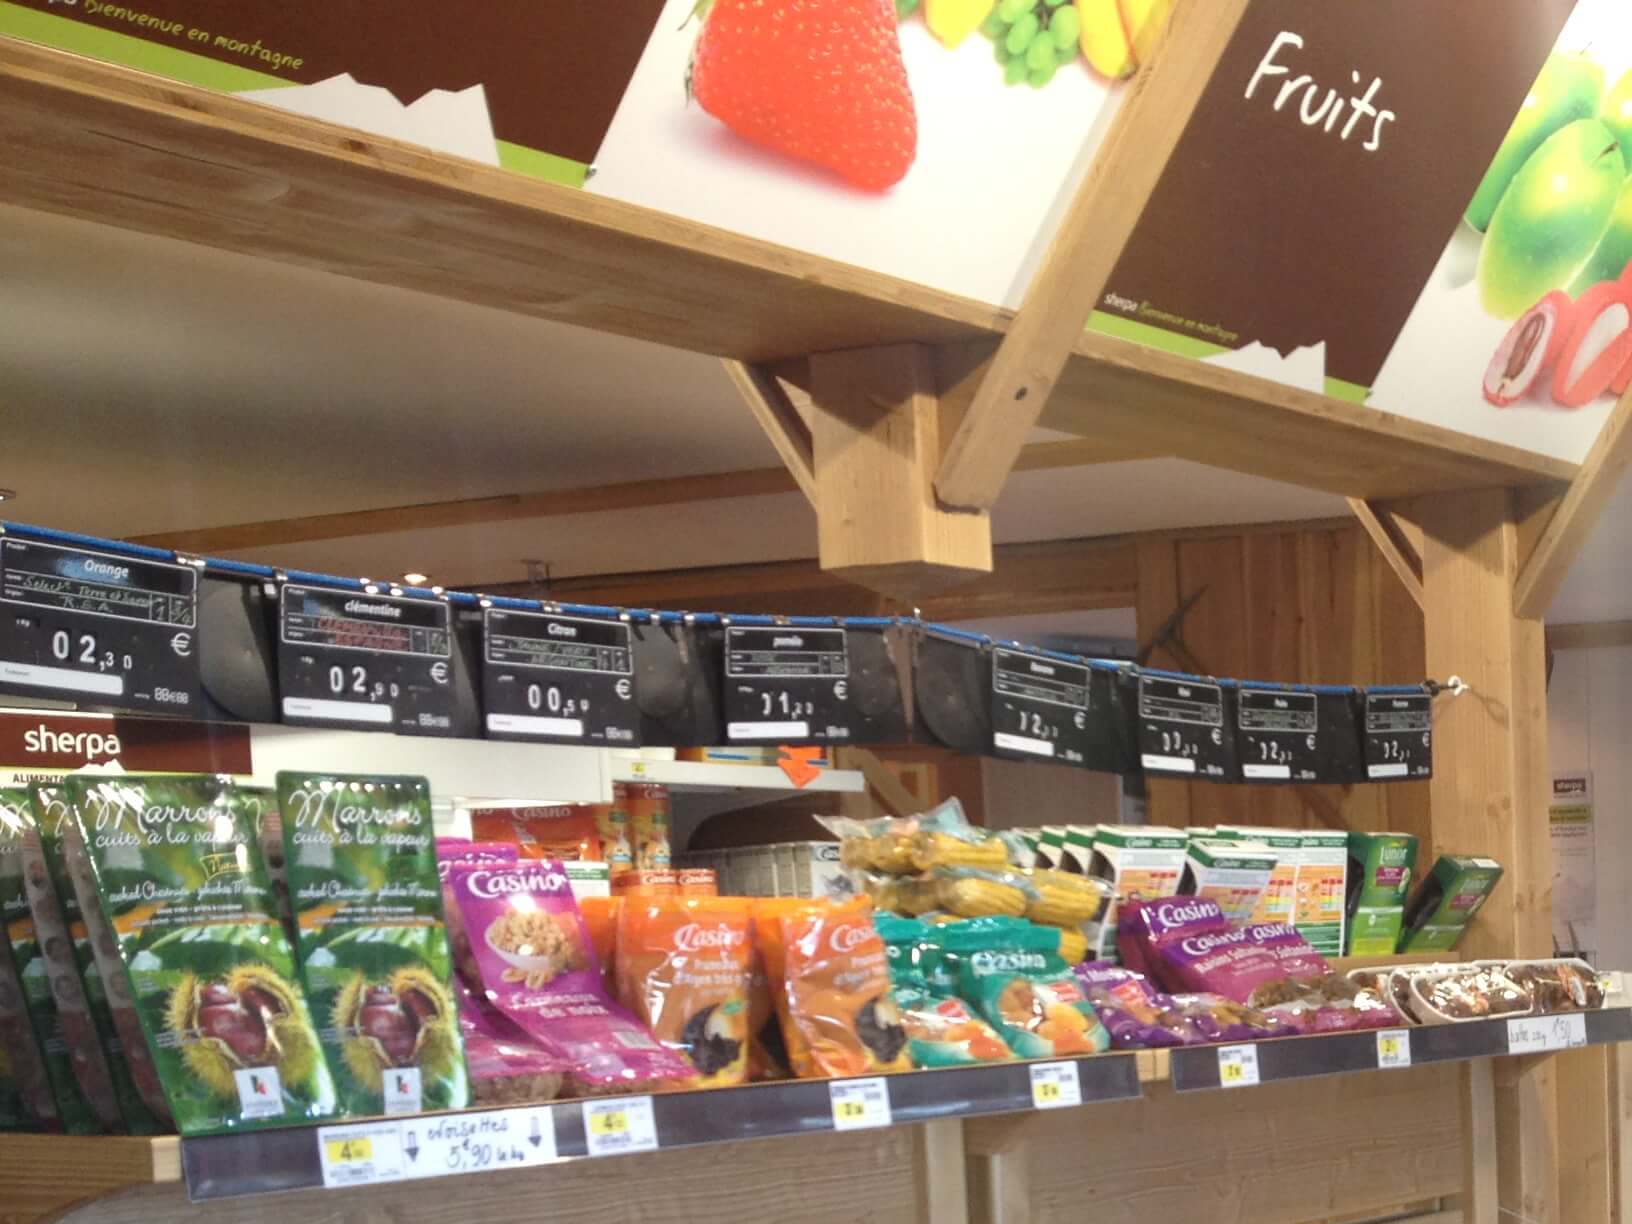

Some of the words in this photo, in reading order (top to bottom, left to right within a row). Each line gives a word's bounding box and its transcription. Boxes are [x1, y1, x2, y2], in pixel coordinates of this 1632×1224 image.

[187, 28, 209, 43] en
[214, 39, 304, 71] montagne
[1245, 31, 1396, 152] Fruits
[84, 559, 129, 580] Orange
[344, 600, 402, 617] clémentine
[24, 724, 122, 760] sherpa
[85, 782, 237, 834] Marrons
[288, 789, 422, 833] Marrons
[512, 807, 572, 821] Casino
[96, 831, 141, 848] cuits
[147, 831, 162, 844] à
[166, 823, 190, 844] la
[293, 831, 335, 845] cuits
[339, 832, 352, 845] à
[356, 823, 377, 845] la
[467, 870, 568, 898] Casino
